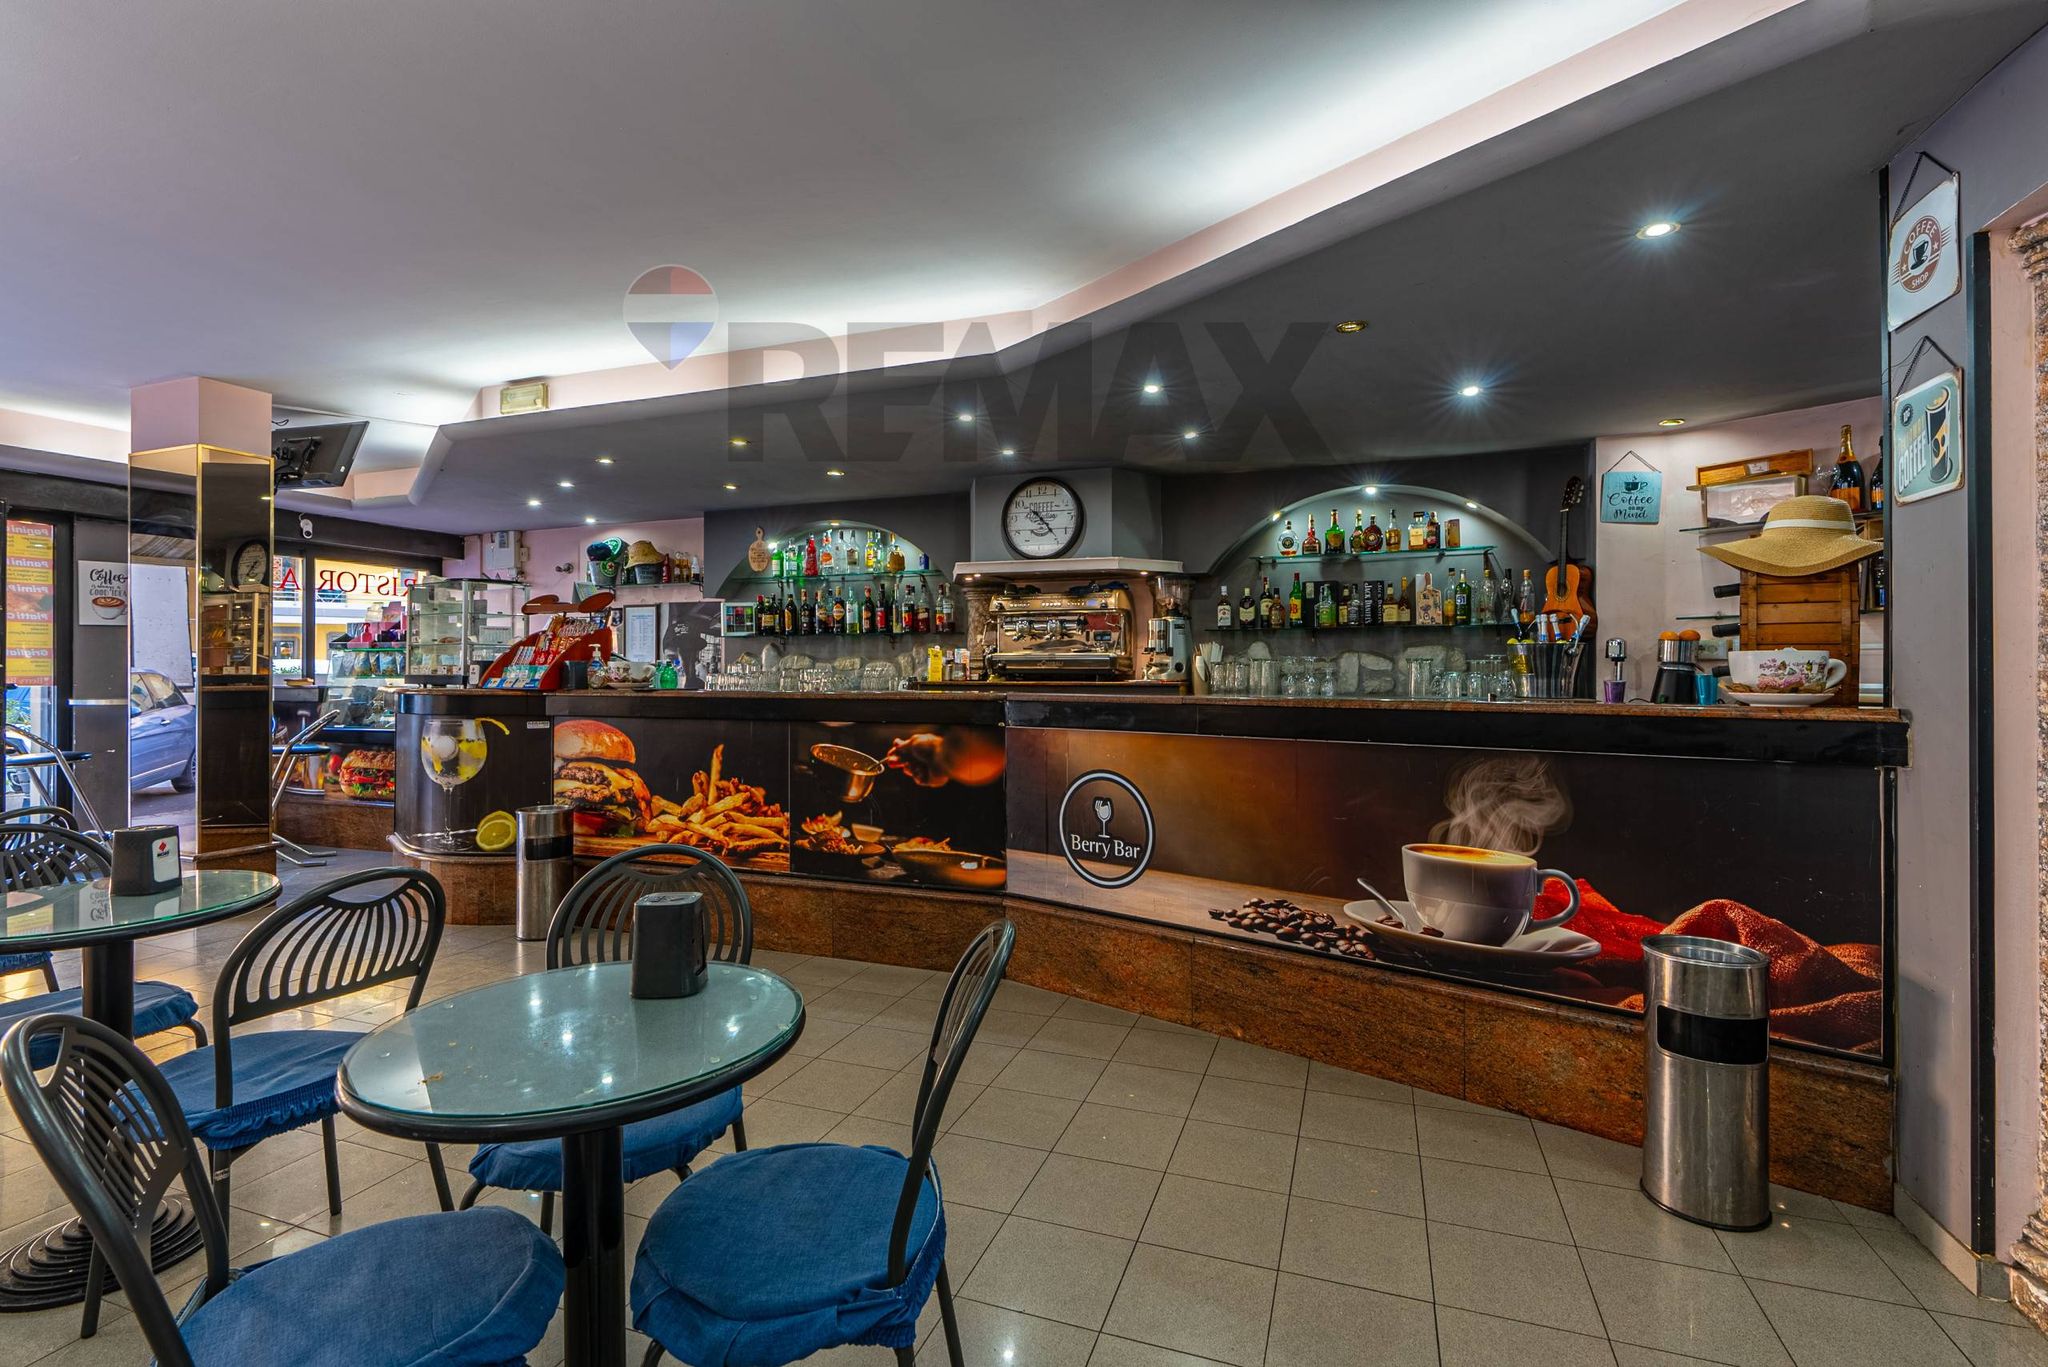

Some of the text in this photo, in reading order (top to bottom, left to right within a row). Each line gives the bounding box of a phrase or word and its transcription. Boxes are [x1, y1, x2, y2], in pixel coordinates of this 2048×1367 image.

[1903, 220, 1938, 254] COFFEE
[1911, 271, 1929, 289] SHOP
[1898, 430, 1926, 493] COFFEE
[1608, 492, 1654, 506] Coffee
[1613, 509, 1648, 519] Mind
[90, 568, 128, 585] Coffee
[1364, 582, 1373, 599] JACK
[1070, 833, 1140, 859] Berry Bar
